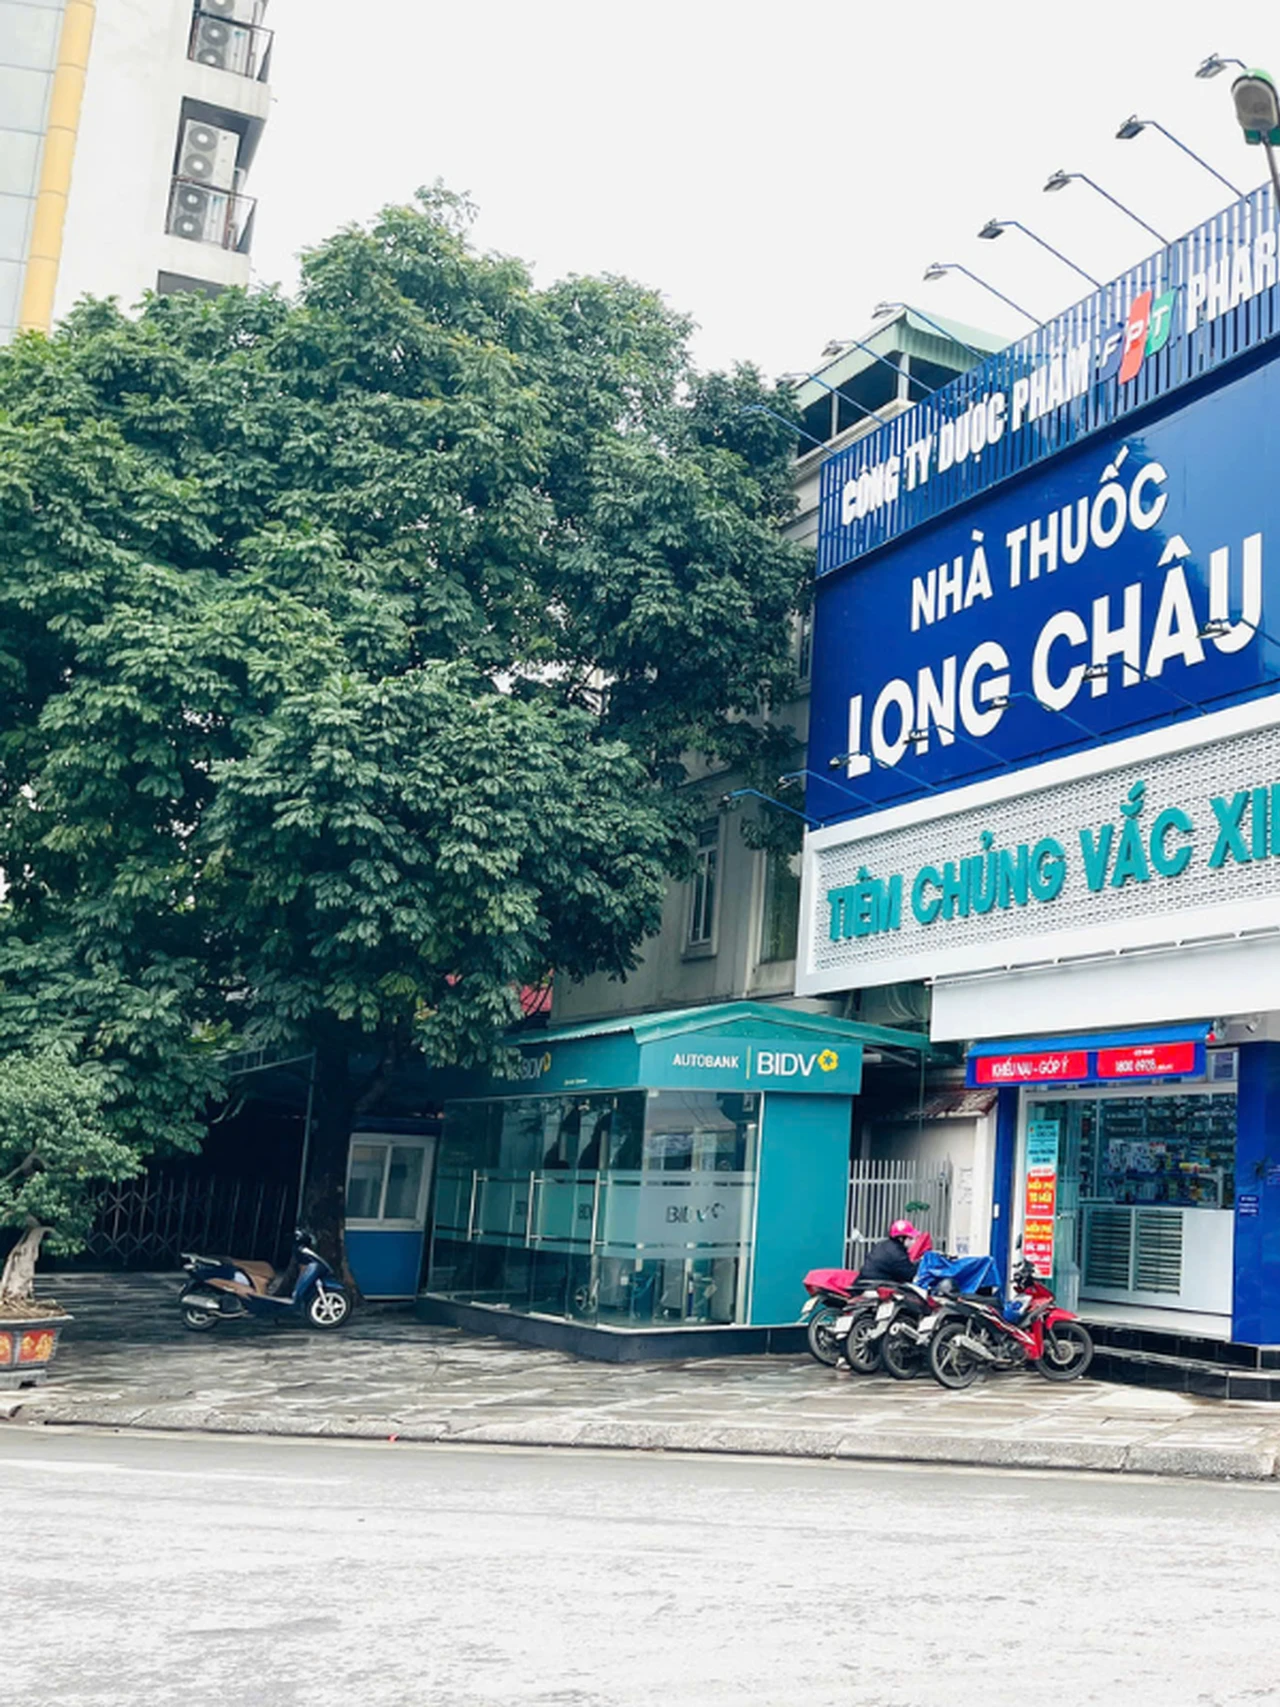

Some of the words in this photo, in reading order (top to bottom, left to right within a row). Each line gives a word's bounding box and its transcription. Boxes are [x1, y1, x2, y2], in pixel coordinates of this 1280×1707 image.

[841, 457, 900, 526] CÔNG
[904, 437, 932, 492] TY
[938, 392, 1005, 474] DƯỢC
[1012, 338, 1090, 432] PHẨM
[1098, 297, 1173, 377] FPT
[910, 528, 993, 631] NHÀ
[1006, 446, 1169, 587] THUỐC
[847, 641, 1010, 779] LONG
[1032, 533, 1263, 712] CHÂU
[827, 866, 903, 943] TIÊM
[910, 831, 1067, 926] CHỦNG
[1079, 780, 1194, 893] VẮC
[673, 1053, 739, 1069] AUTOBANK
[756, 1051, 818, 1077] BIDV
[1039, 1057, 1060, 1075] GÓP
